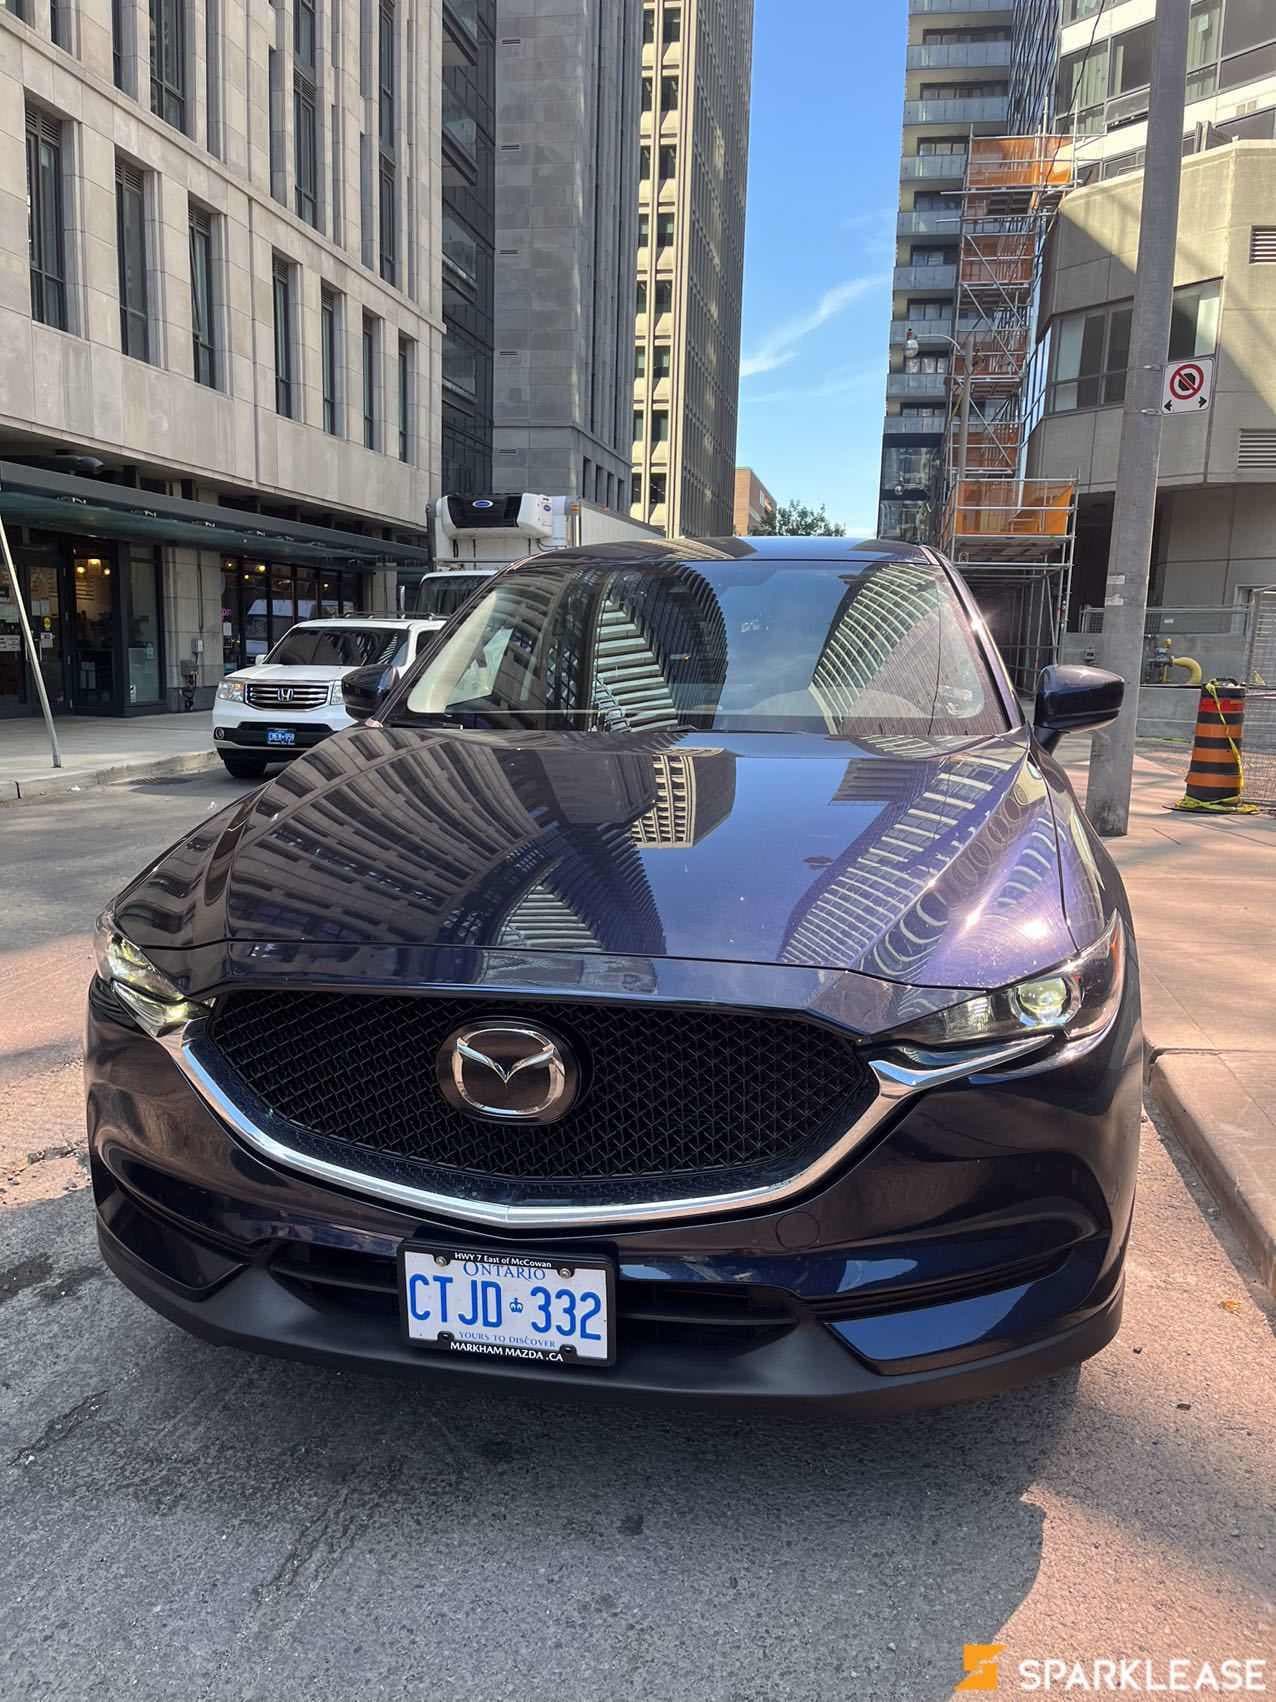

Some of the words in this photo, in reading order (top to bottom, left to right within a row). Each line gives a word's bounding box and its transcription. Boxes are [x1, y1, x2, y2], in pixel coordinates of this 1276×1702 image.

[454, 1252, 475, 1261] HWY
[483, 1255, 500, 1264] East
[501, 1257, 511, 1265] of
[511, 1258, 552, 1269] McCowan
[463, 1260, 546, 1281] ONTARIO
[408, 1273, 503, 1329] CTJD
[529, 1286, 601, 1341] 332
[458, 1331, 490, 1342] YOURS
[493, 1334, 506, 1343] TO
[508, 1336, 556, 1348] DISCOVER
[450, 1341, 503, 1356] MARKHAM
[505, 1347, 543, 1361] MAZDA
